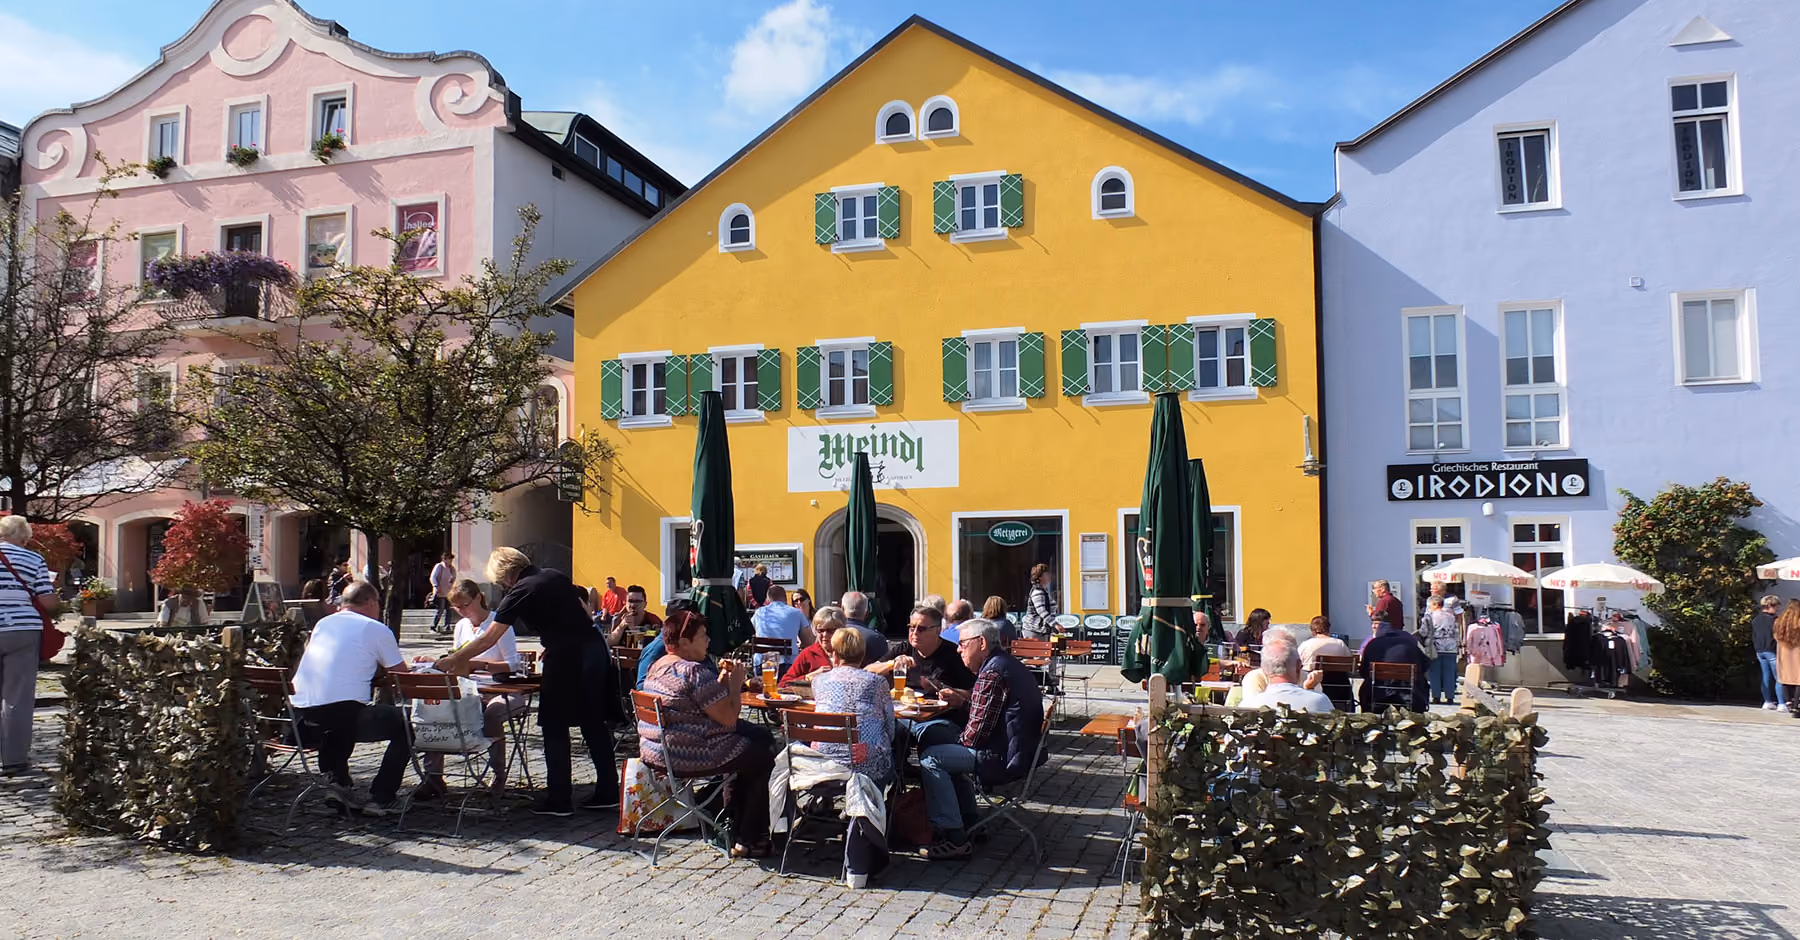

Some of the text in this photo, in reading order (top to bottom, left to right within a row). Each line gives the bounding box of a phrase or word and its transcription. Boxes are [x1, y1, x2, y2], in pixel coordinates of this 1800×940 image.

[818, 424, 925, 479] Meindl
[1432, 461, 1538, 473] Griechisches Restaurant
[1417, 472, 1557, 498] IRODION
